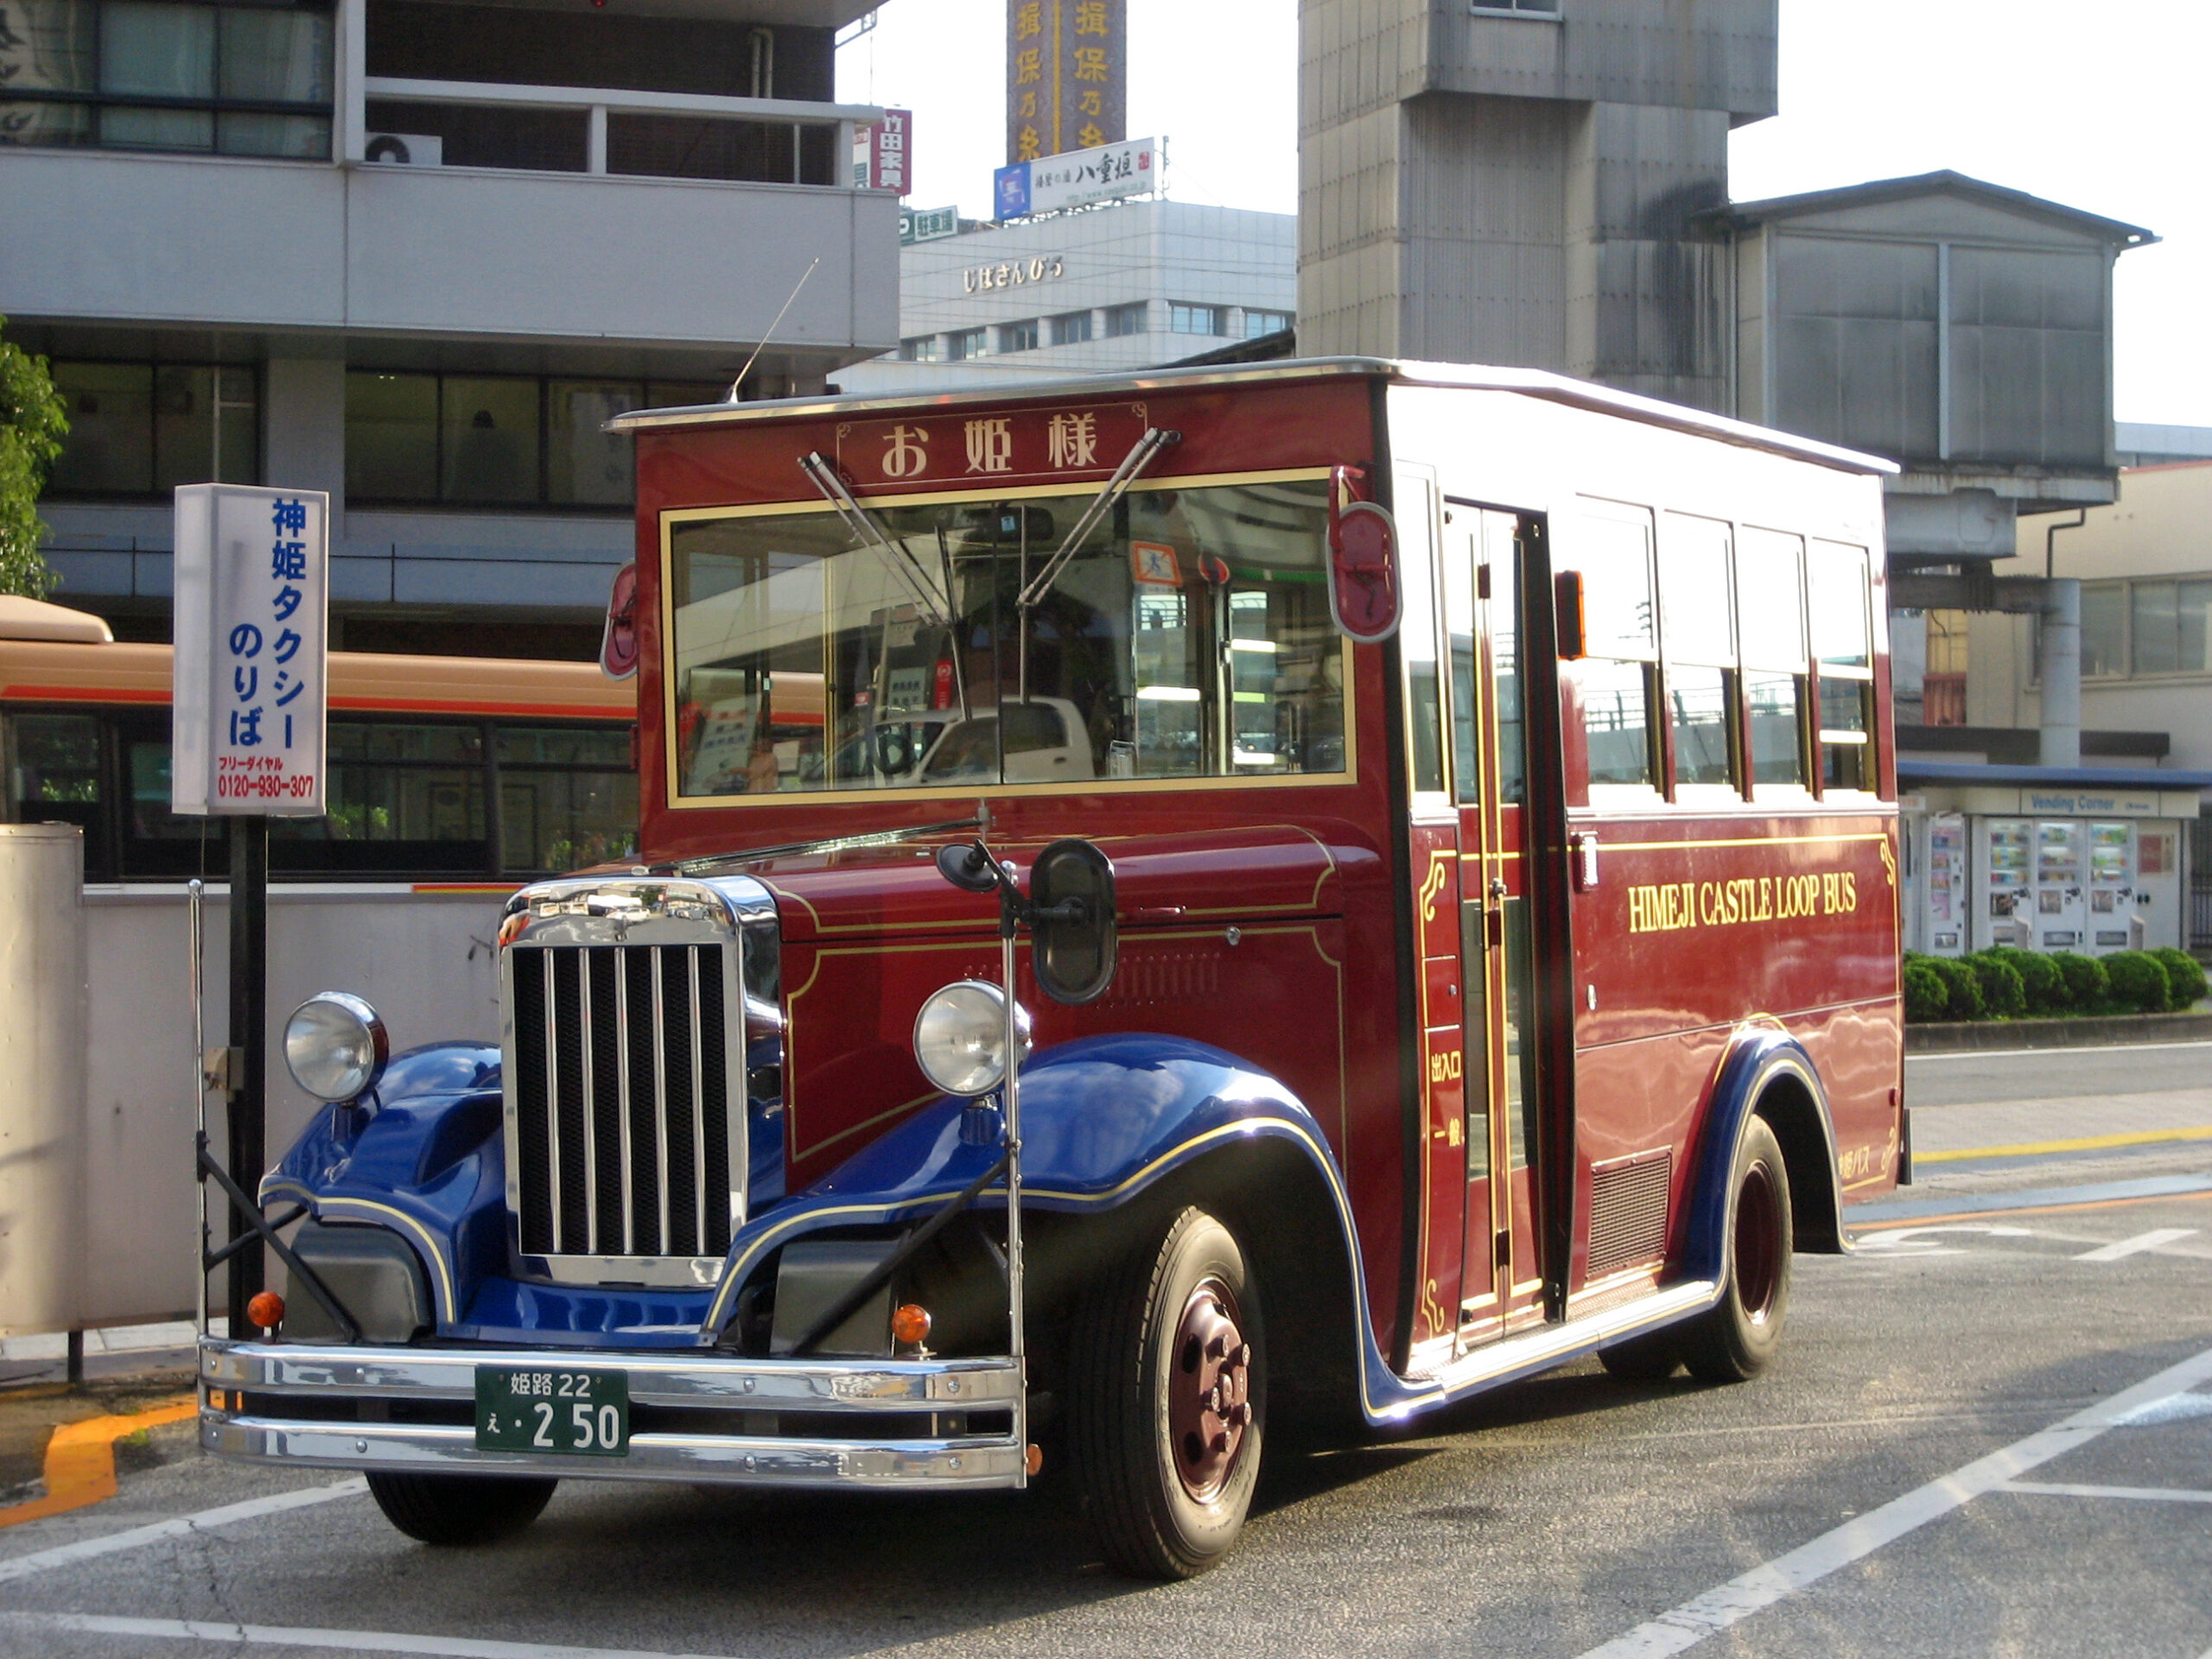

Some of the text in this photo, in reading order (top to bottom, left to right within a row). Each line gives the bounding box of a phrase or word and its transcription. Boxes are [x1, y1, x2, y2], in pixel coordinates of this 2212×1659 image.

[880, 114, 904, 188] 竹田家具
[1076, 151, 1134, 184] 八重垣
[881, 411, 1098, 477] お姫様
[271, 499, 307, 749] 神姫タクシー
[230, 623, 264, 747] のりば
[218, 756, 283, 771] フリーダイヤル
[218, 774, 314, 798] 0120-930-307
[2031, 794, 2074, 813] Vending
[2078, 795, 2115, 810] Corner
[1628, 872, 1857, 933] HIMEJI CASTLE LOOP BUS
[1431, 1051, 1461, 1083] 出入口
